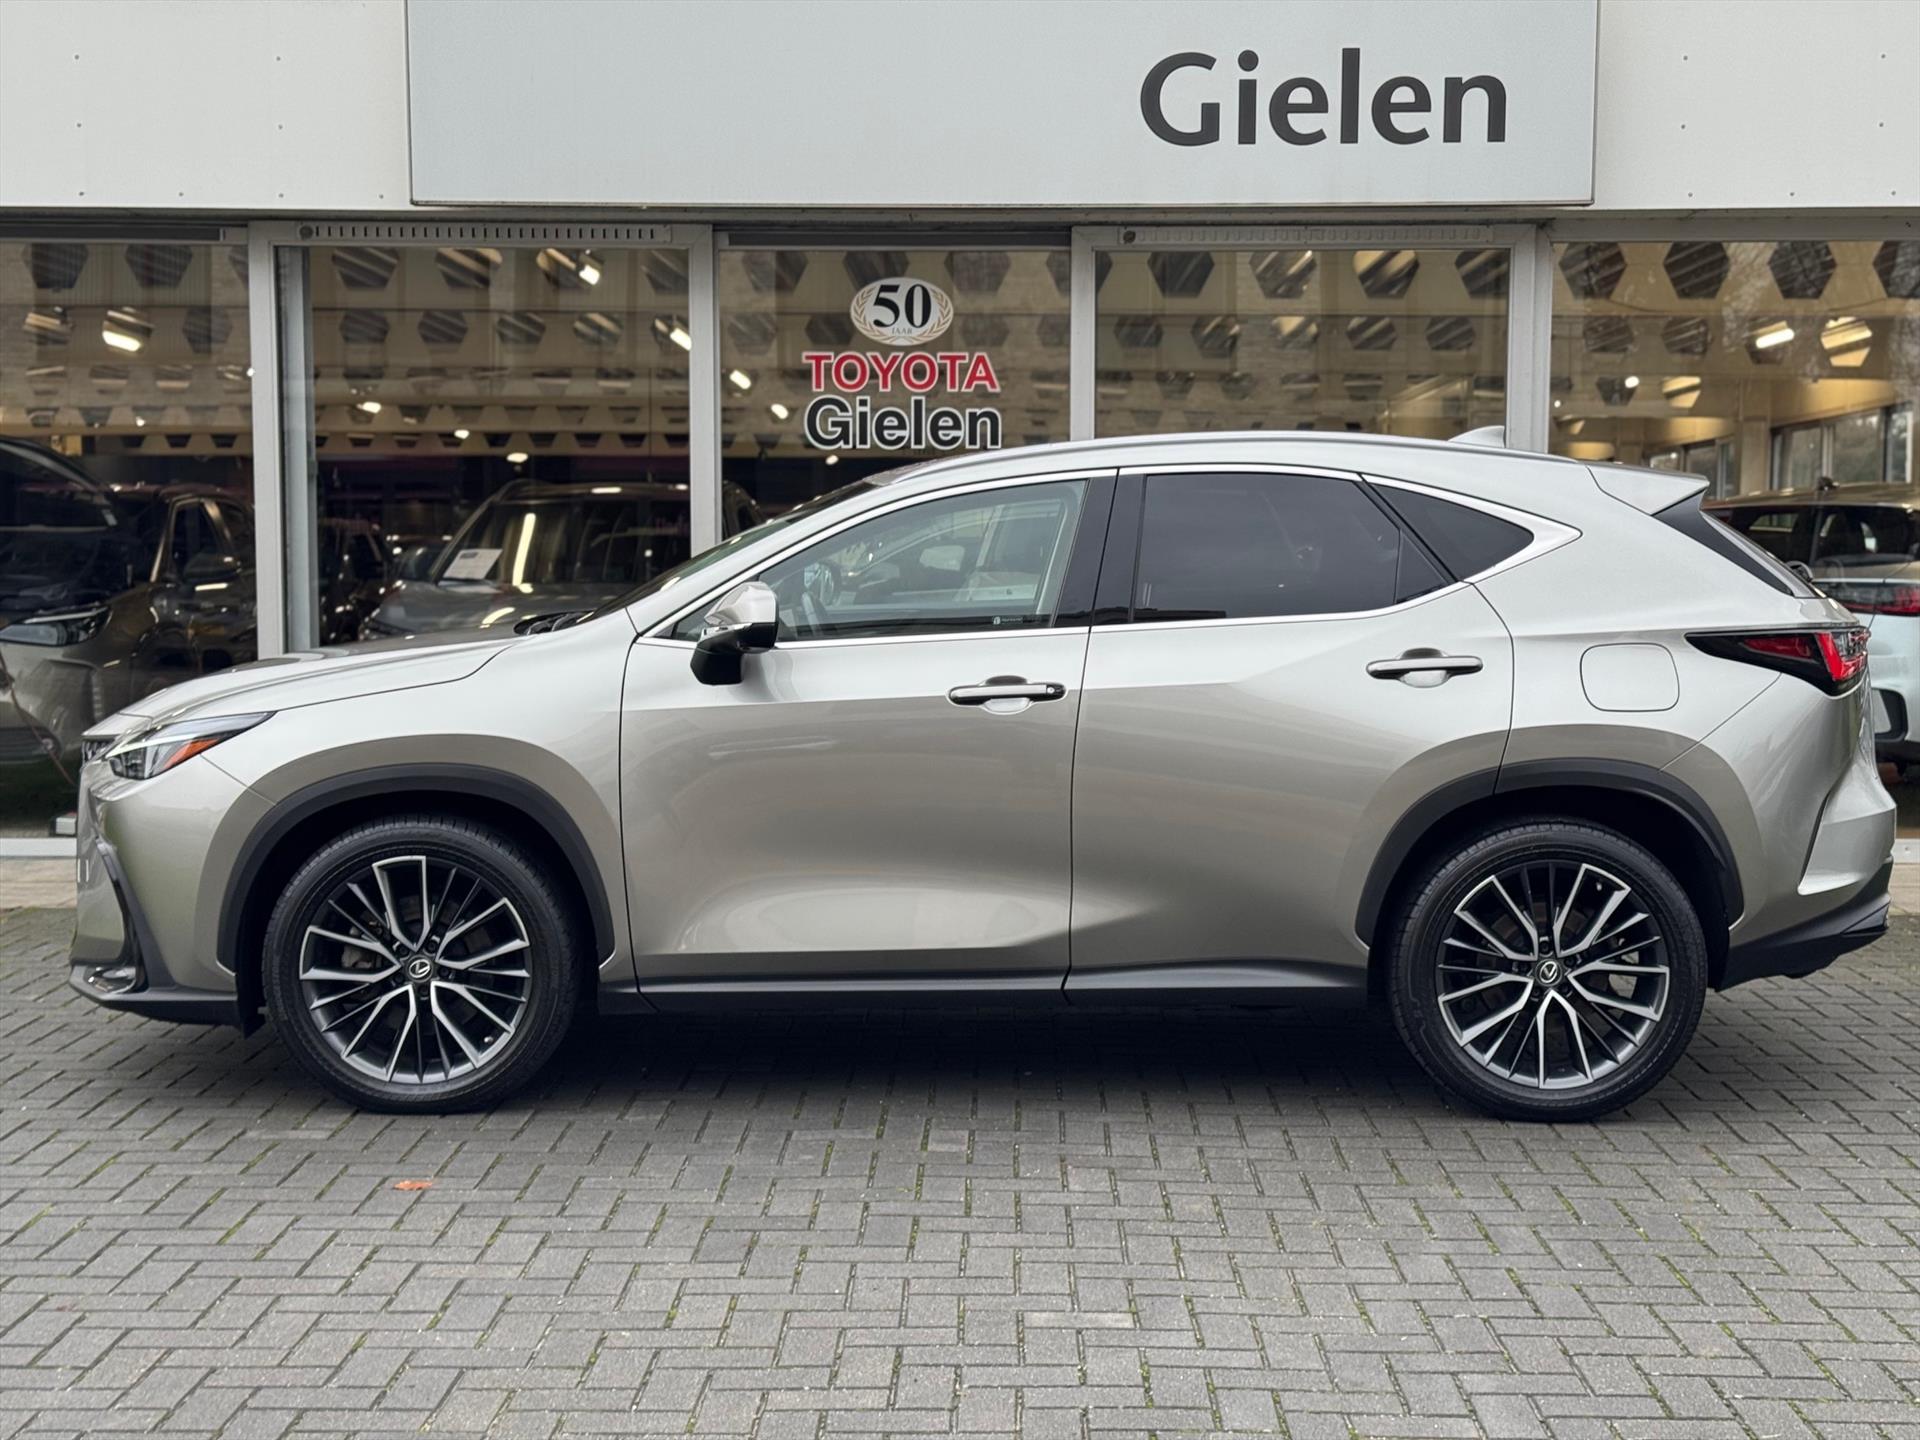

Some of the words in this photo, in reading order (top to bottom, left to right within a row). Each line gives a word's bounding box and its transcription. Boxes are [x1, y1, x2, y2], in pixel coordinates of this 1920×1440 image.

[1140, 47, 1507, 147] Gielen
[873, 284, 932, 328] 50
[802, 351, 1000, 392] TOYOTA
[804, 394, 1002, 450] Gielen
